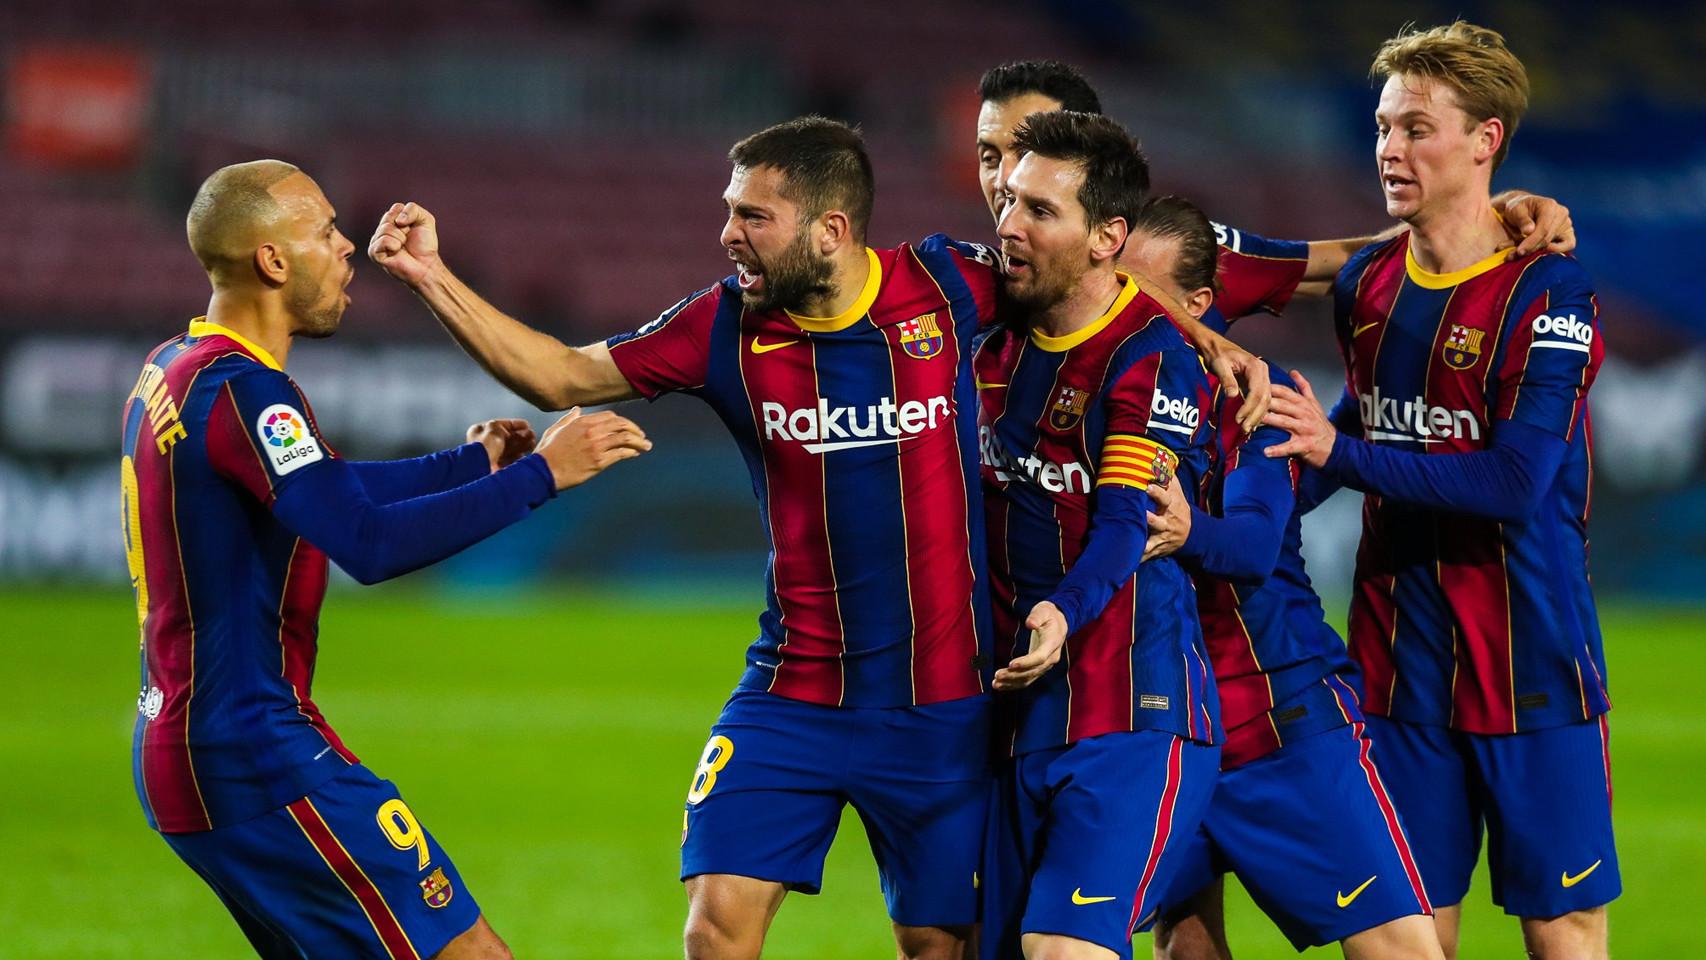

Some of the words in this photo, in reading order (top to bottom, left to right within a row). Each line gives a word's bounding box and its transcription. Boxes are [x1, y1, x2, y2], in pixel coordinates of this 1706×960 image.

[762, 395, 950, 441] Rakuten
[1152, 388, 1199, 428] beko
[1359, 386, 1480, 440] akuten
[276, 445, 315, 466] LaLiga
[979, 425, 1091, 494] Raten
[687, 734, 734, 806] 8
[376, 798, 432, 872] 9
